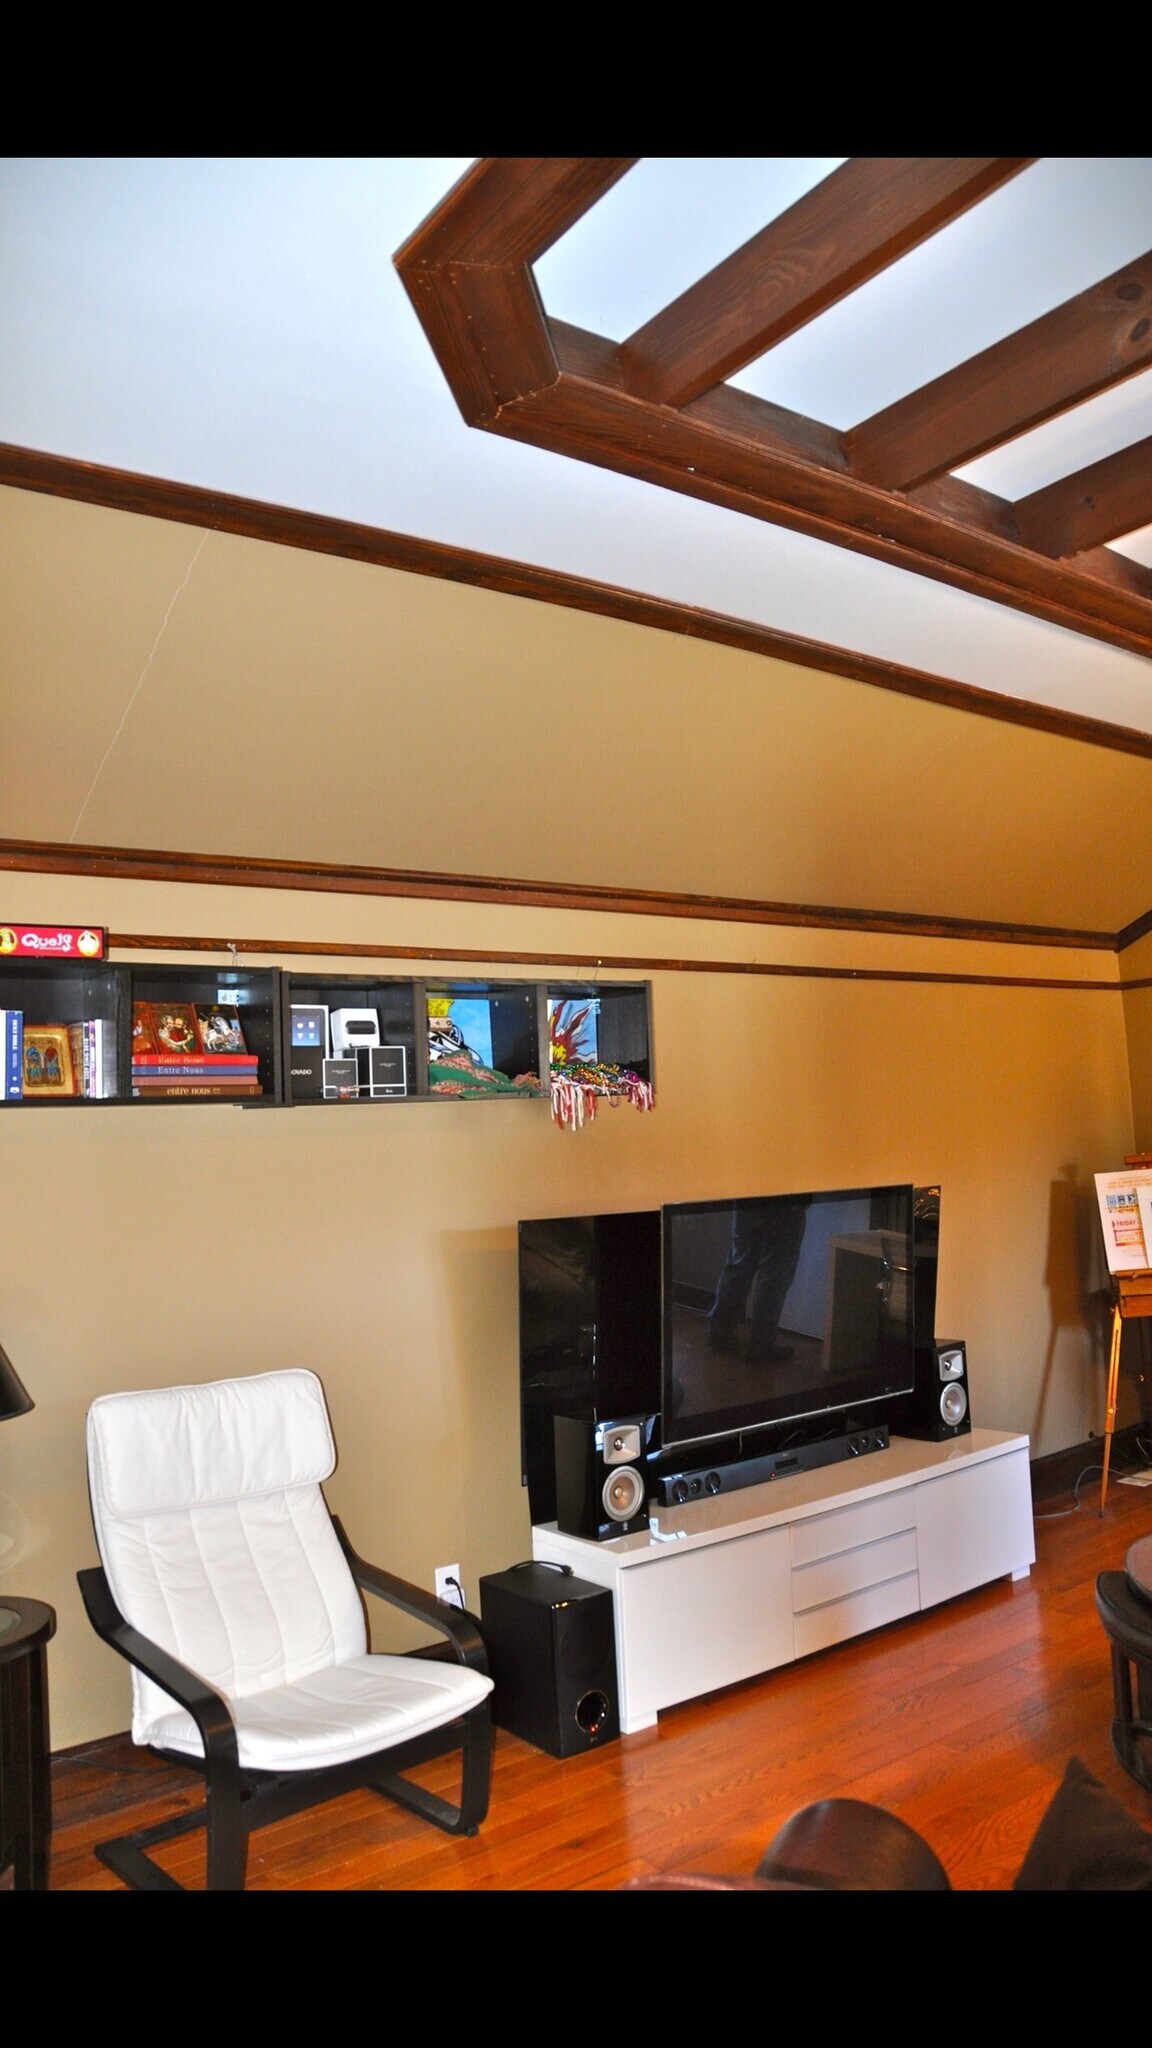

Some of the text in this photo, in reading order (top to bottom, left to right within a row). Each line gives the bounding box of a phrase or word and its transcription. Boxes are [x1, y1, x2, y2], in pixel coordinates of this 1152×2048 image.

[158, 1066, 204, 1074] Entre Nous
[167, 1086, 189, 1095] entre
[191, 1087, 211, 1095] nous
